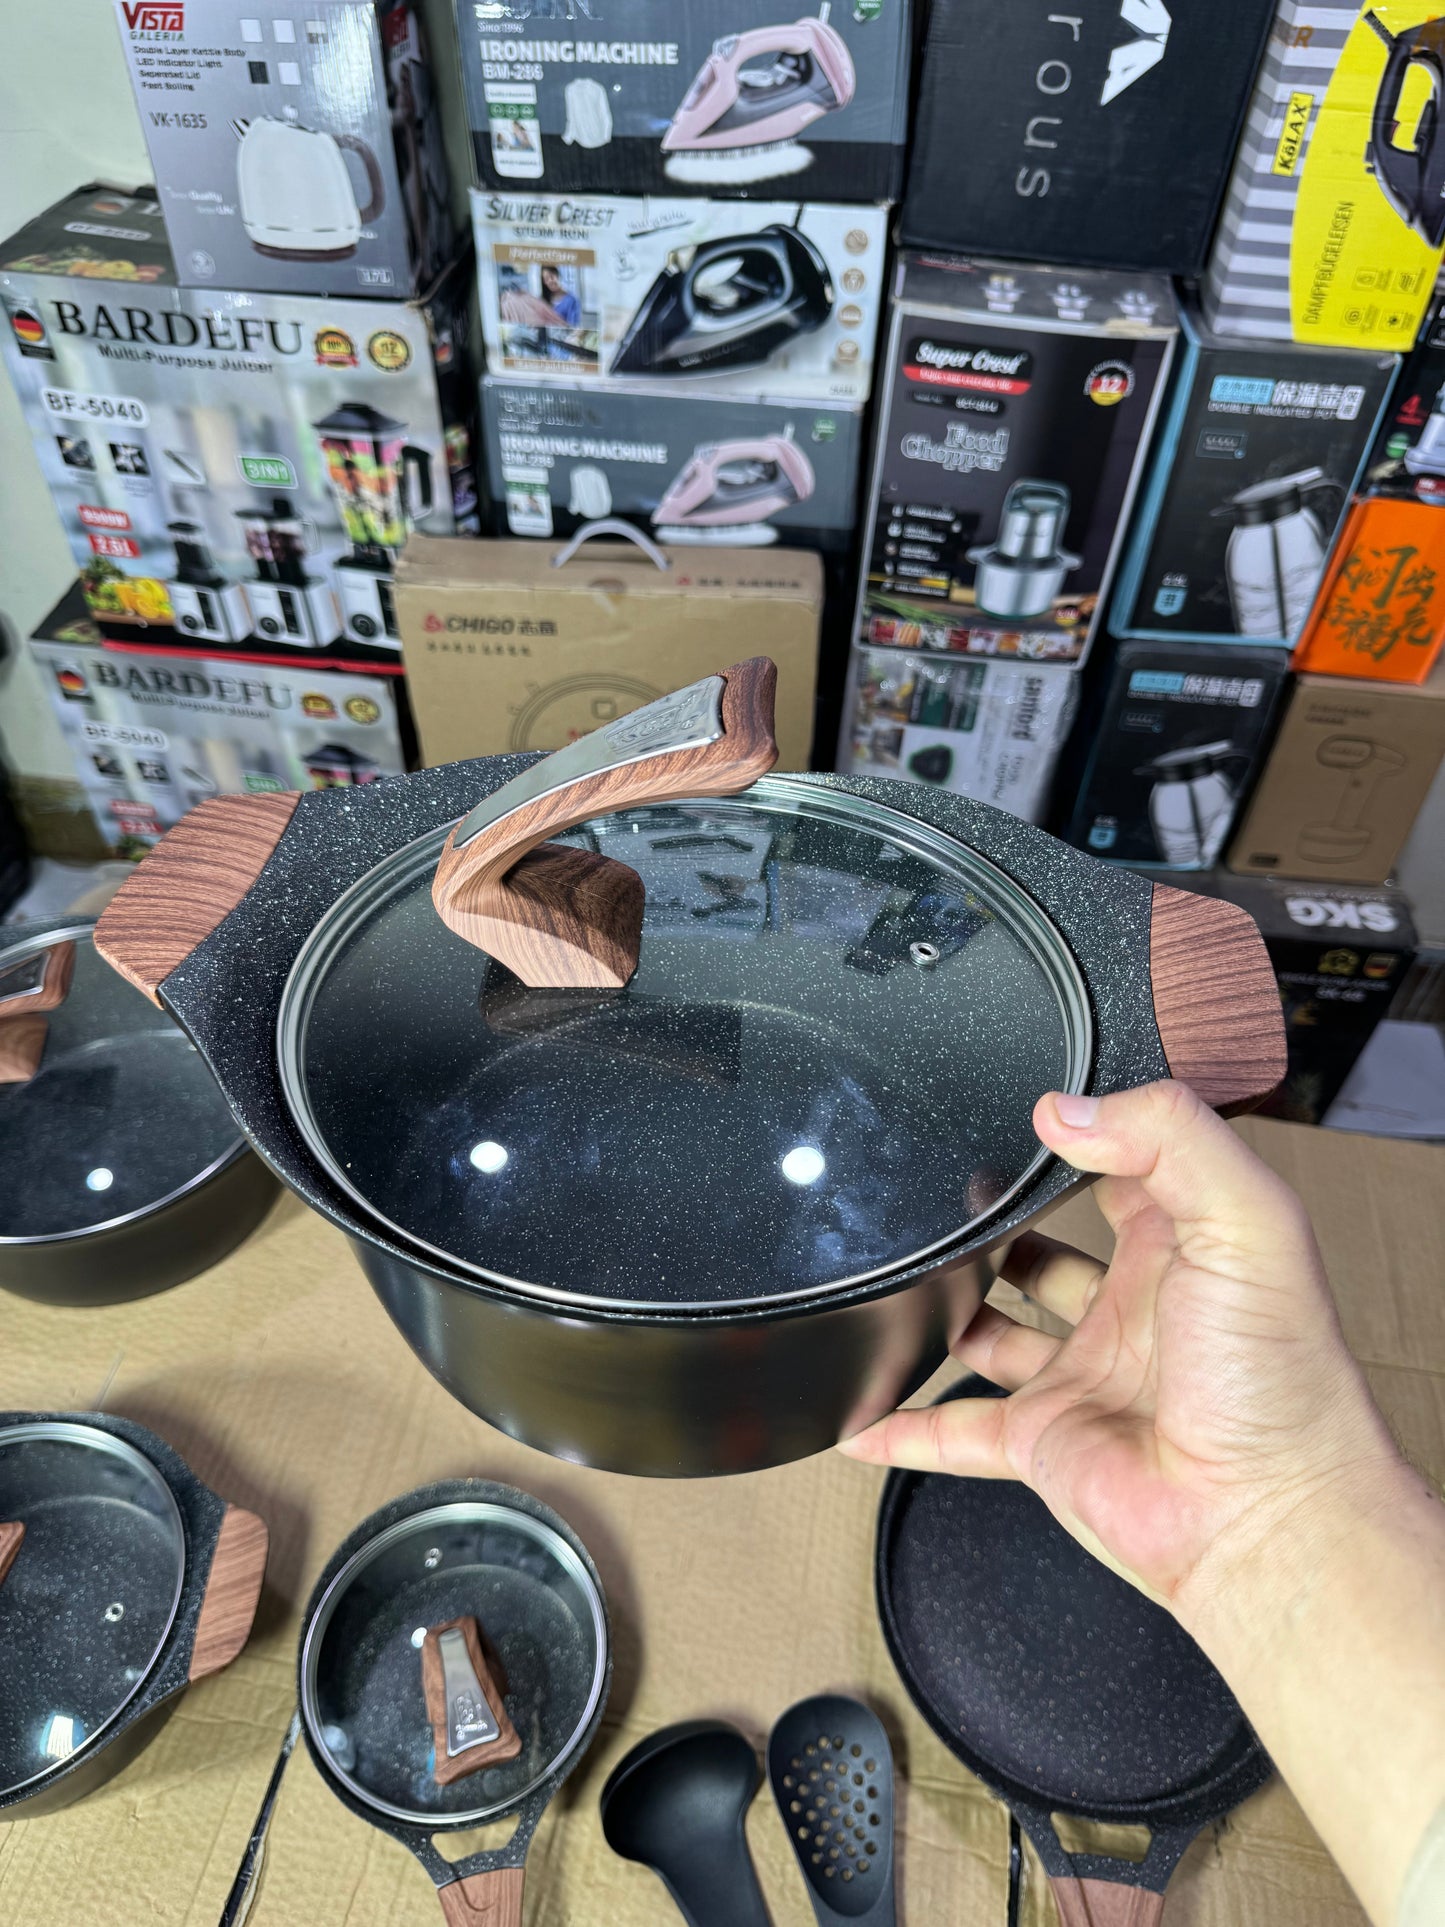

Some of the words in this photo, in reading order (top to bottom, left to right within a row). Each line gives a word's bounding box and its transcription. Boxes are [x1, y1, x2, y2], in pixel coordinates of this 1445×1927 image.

[130, 31, 185, 41] GALERIA
[480, 40, 574, 62] IRONING
[576, 42, 679, 65] MACHINE
[150, 111, 208, 129] VK-1635
[50, 299, 304, 355] BARDEFU
[97, 343, 216, 369] Multi-Purpose
[915, 340, 972, 369] Super
[971, 349, 1022, 375] Crest
[46, 391, 144, 421] BF-5040
[582, 438, 668, 465] MACHINE
[901, 432, 1007, 473] Chopper
[945, 421, 1010, 454] Food
[446, 615, 515, 635] CHIGO
[91, 659, 293, 710] BARDEFU
[1285, 896, 1399, 932] SKG
